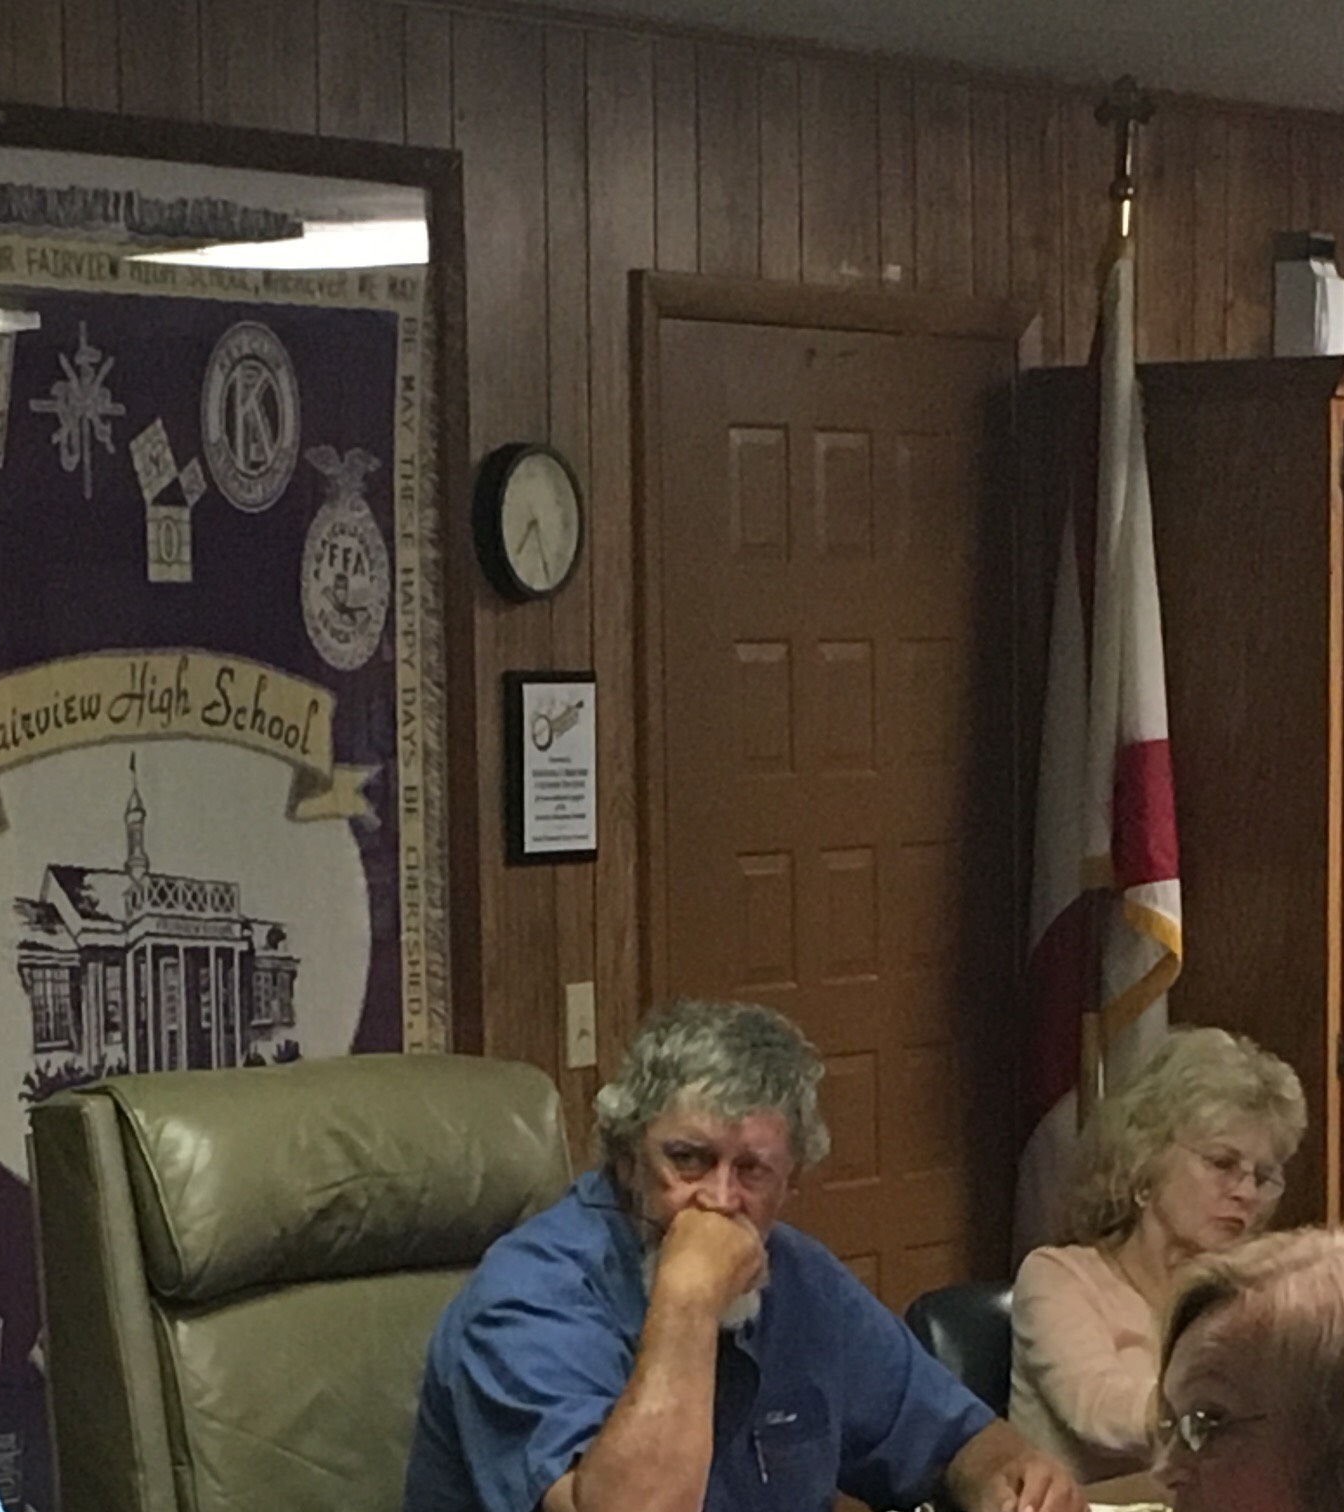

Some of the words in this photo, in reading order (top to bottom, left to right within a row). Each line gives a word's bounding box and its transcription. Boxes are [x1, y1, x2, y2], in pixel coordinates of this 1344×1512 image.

[26, 246, 120, 281] FAIRVIEW
[328, 543, 366, 576] FFA
[400, 567, 417, 670] HAPPY
[107, 653, 191, 729] High
[200, 666, 319, 756] School
[401, 687, 418, 768] DAYS
